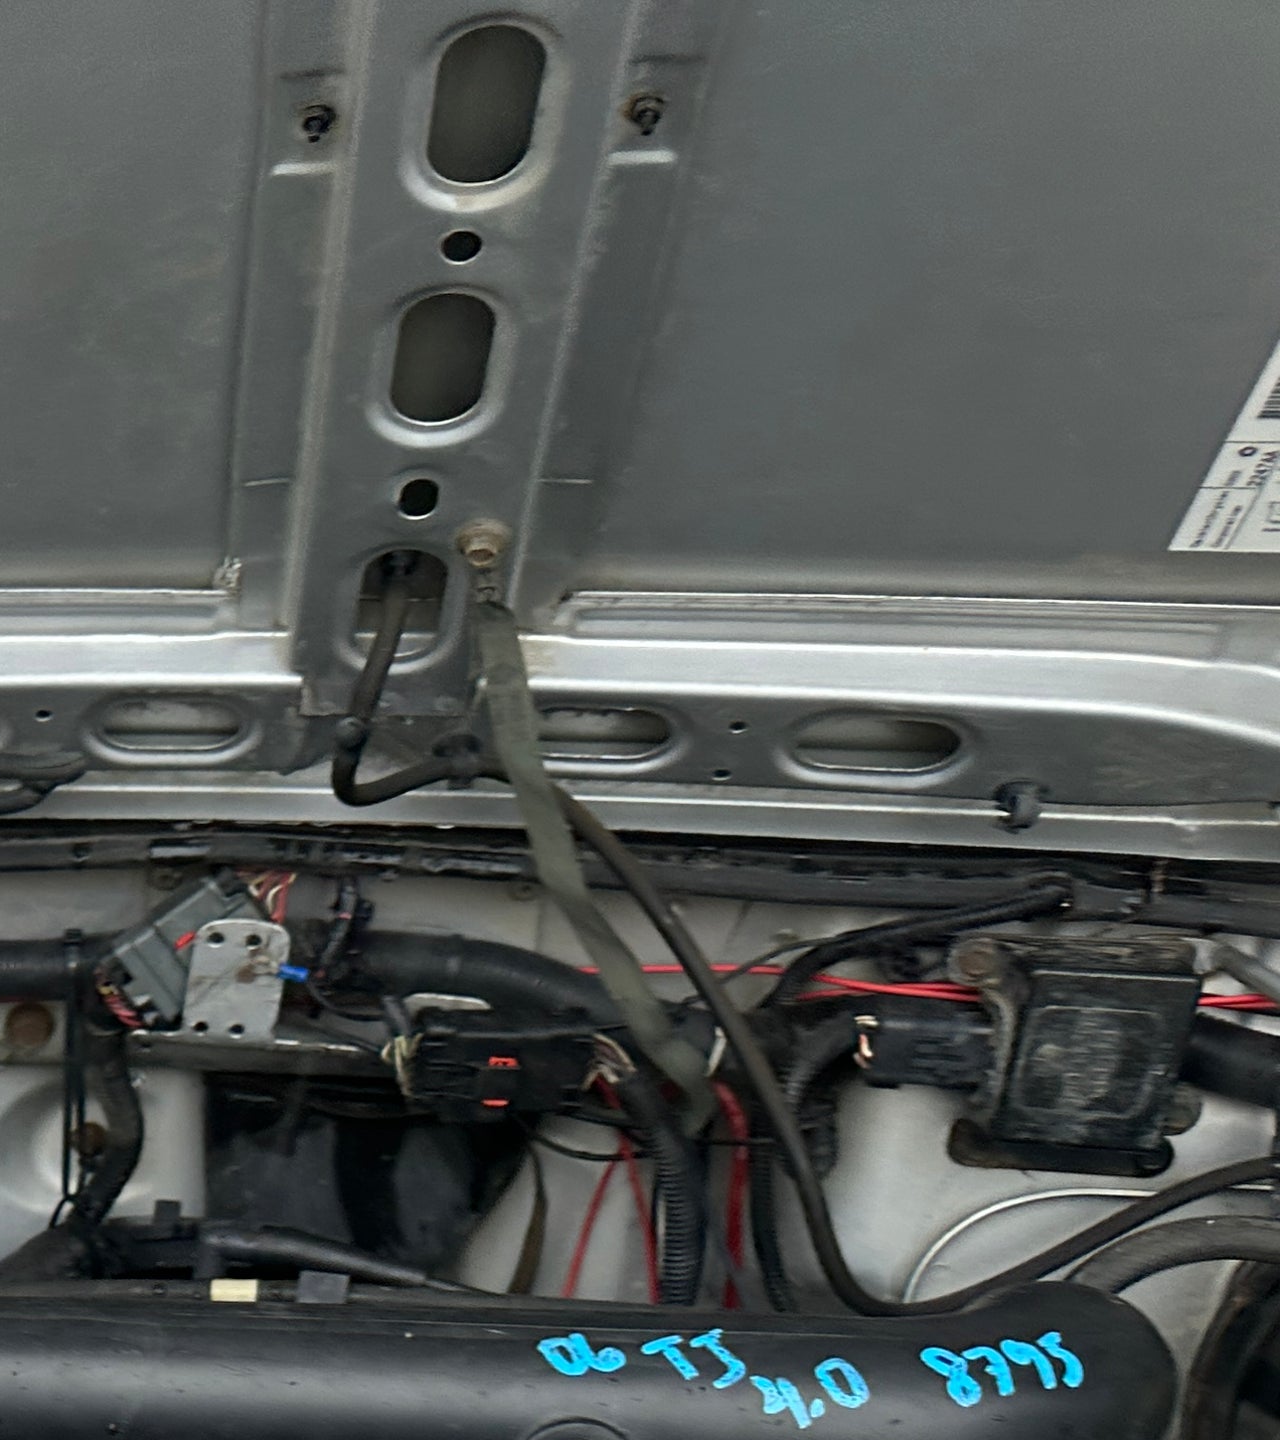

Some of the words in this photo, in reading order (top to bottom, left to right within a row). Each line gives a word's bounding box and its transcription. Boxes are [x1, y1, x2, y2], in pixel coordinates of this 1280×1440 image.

[641, 1328, 746, 1389] TJ
[749, 1357, 870, 1429] 4.0
[920, 1331, 1084, 1408] 8795
